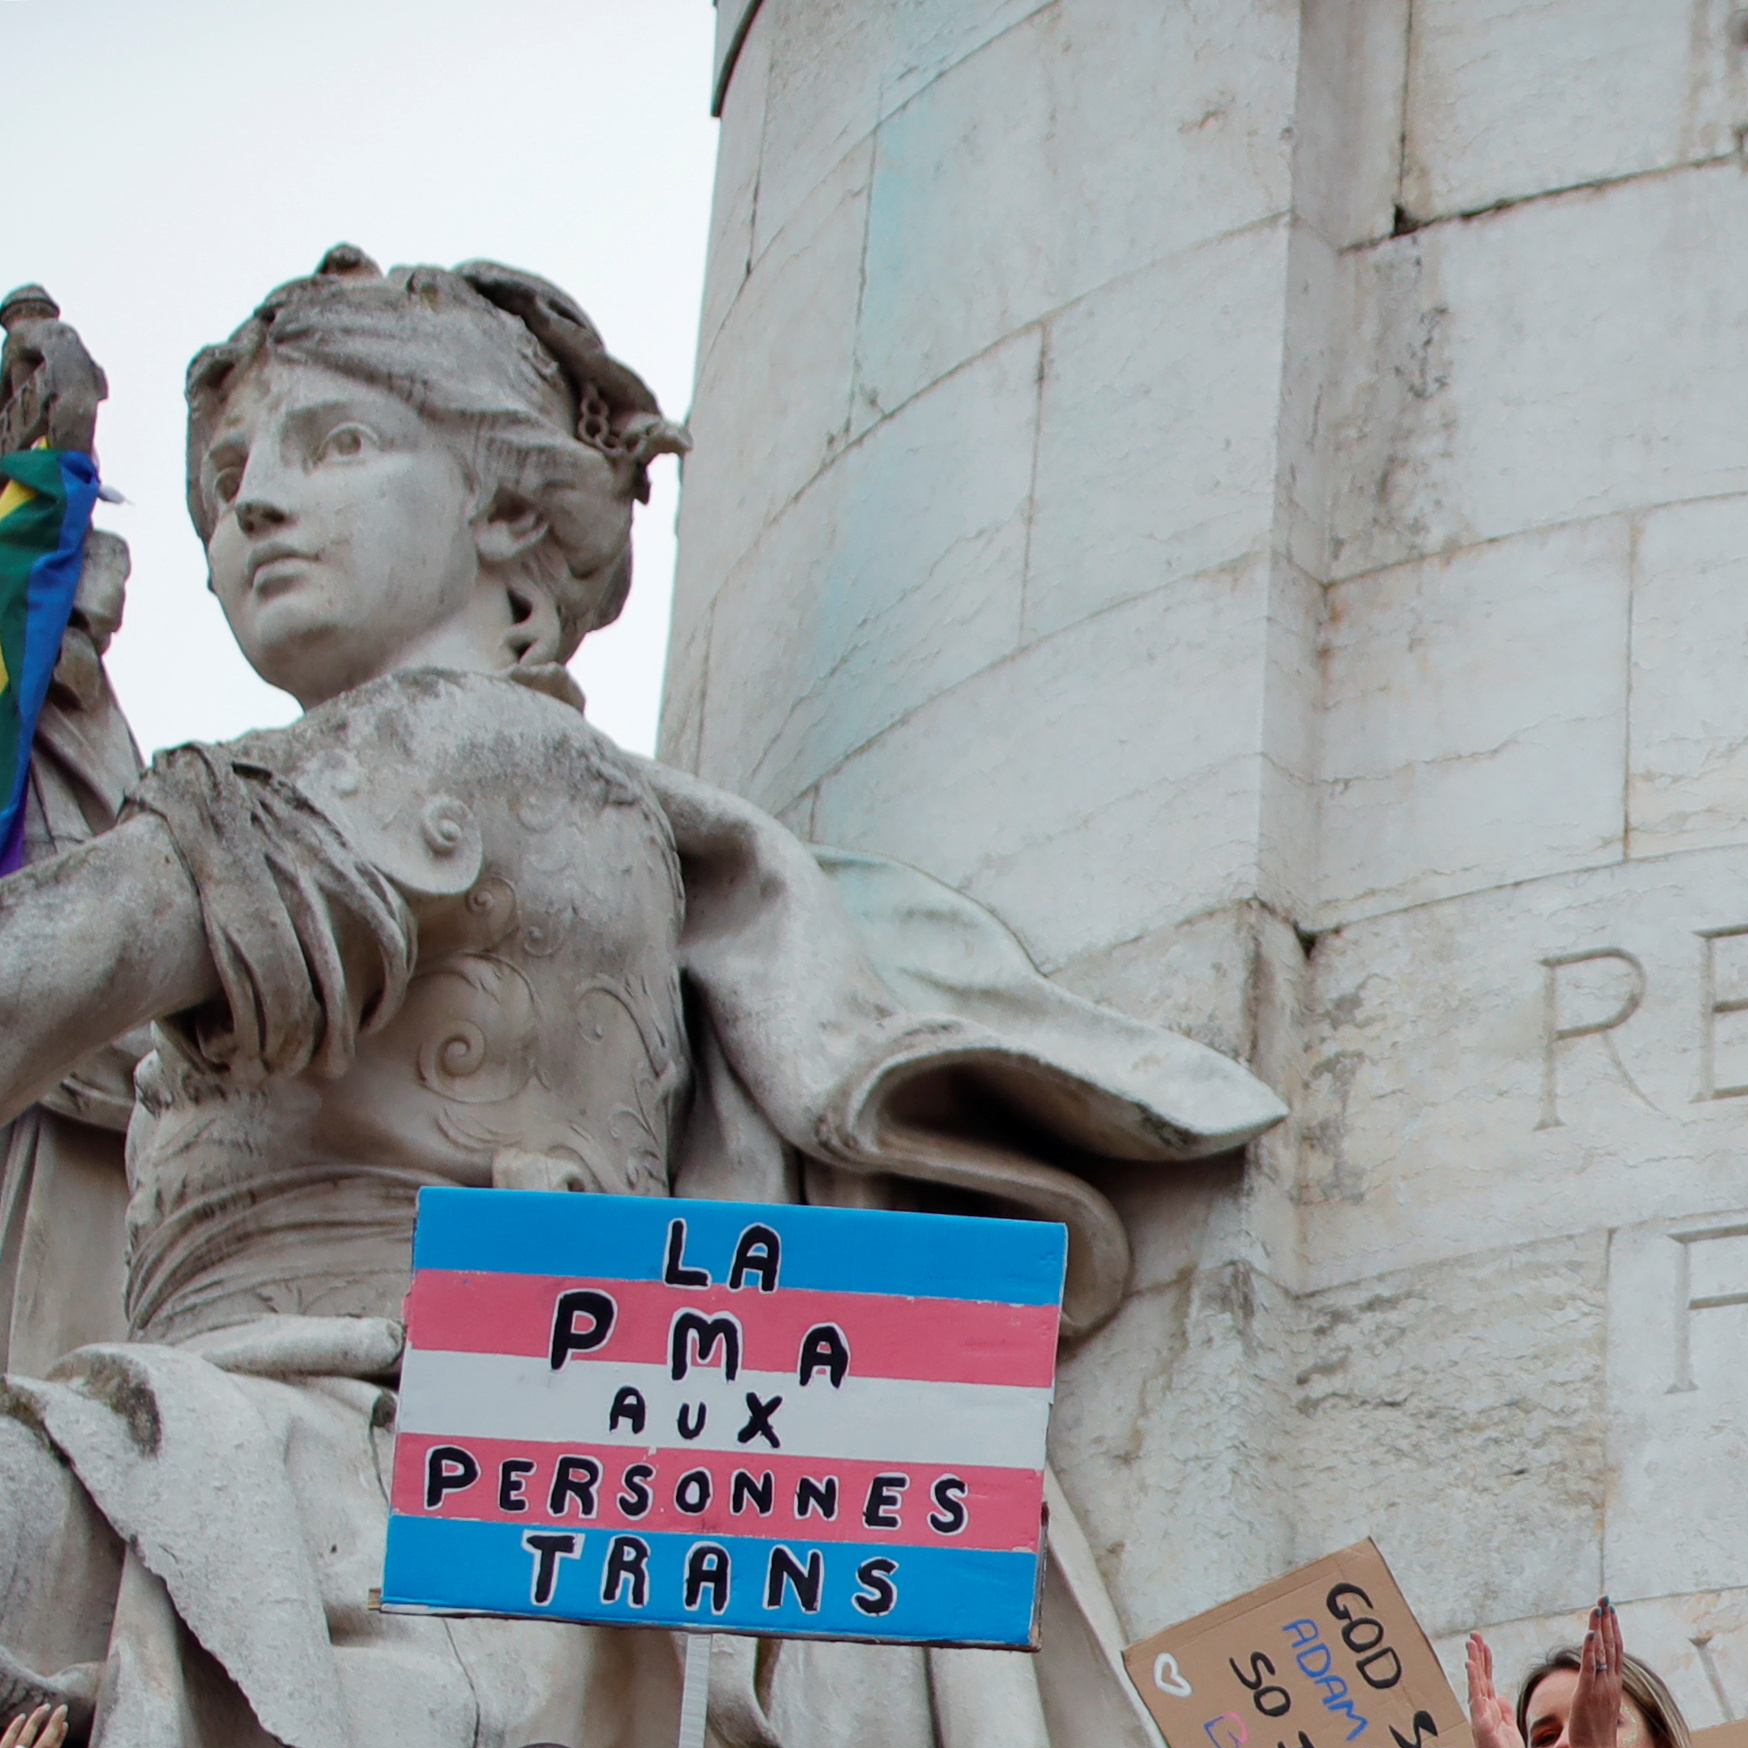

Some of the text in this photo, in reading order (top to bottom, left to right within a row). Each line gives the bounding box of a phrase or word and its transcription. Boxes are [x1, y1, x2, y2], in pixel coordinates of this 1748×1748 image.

[663, 1218, 781, 1292] LA
[549, 1290, 850, 1389] PMA
[608, 1386, 782, 1448] AUX
[425, 1446, 968, 1535] PERSONNES
[523, 1532, 898, 1616] TRANS
[1326, 1582, 1402, 1689] GOD
[1229, 1651, 1292, 1717] SO
[1282, 1618, 1369, 1741] ADAM
